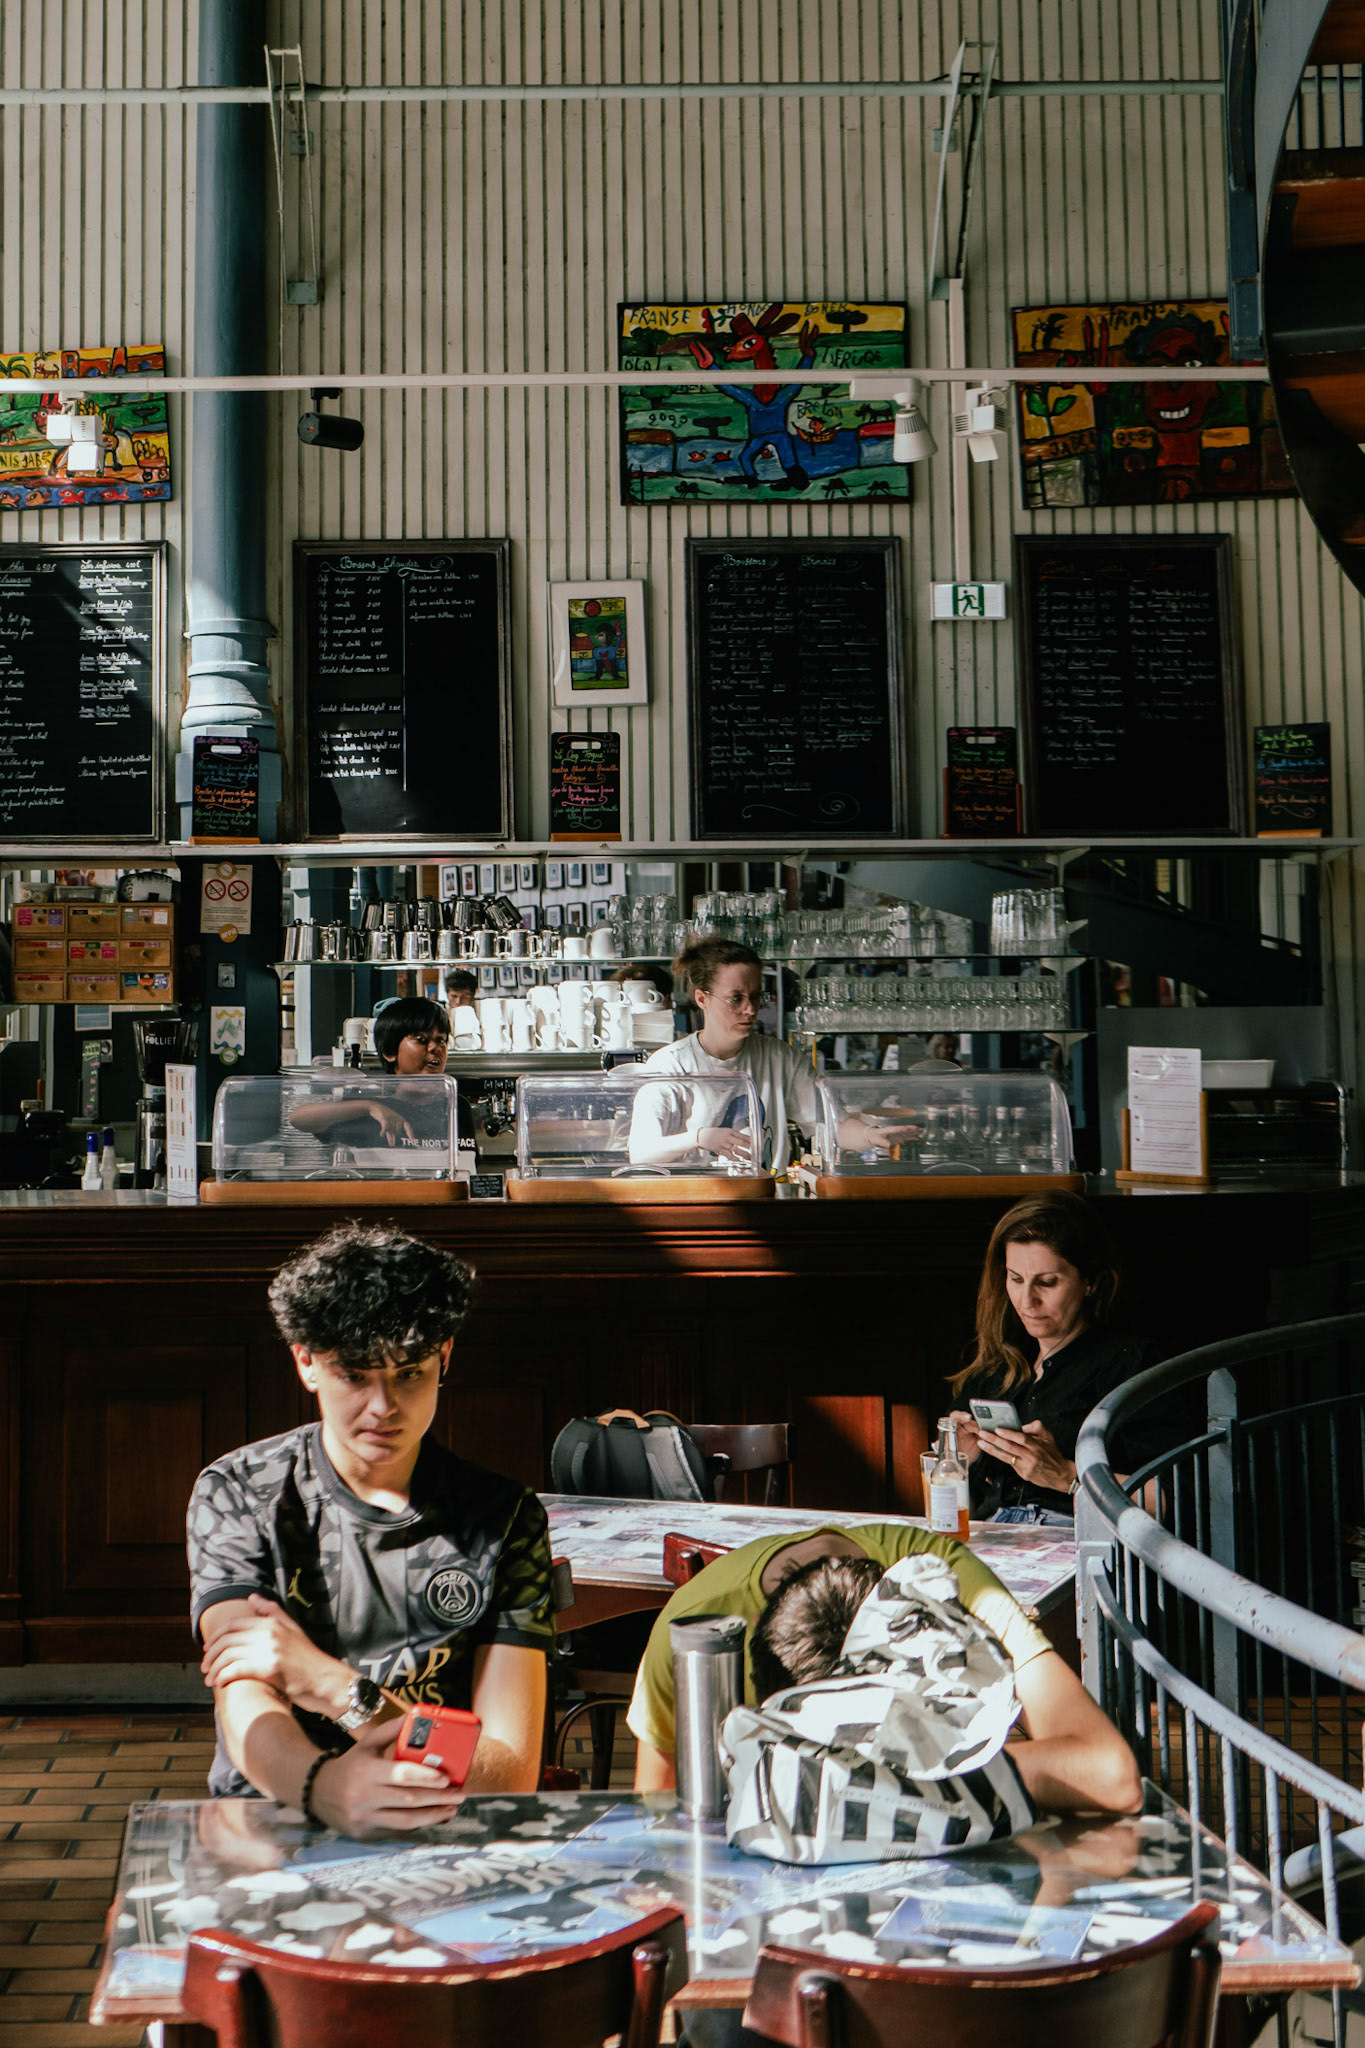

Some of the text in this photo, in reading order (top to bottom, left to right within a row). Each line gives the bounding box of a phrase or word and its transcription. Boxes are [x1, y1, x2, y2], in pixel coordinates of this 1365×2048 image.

[630, 308, 692, 326] FRANSE
[401, 1138, 420, 1147] THE
[435, 1573, 469, 1588] PARIS
